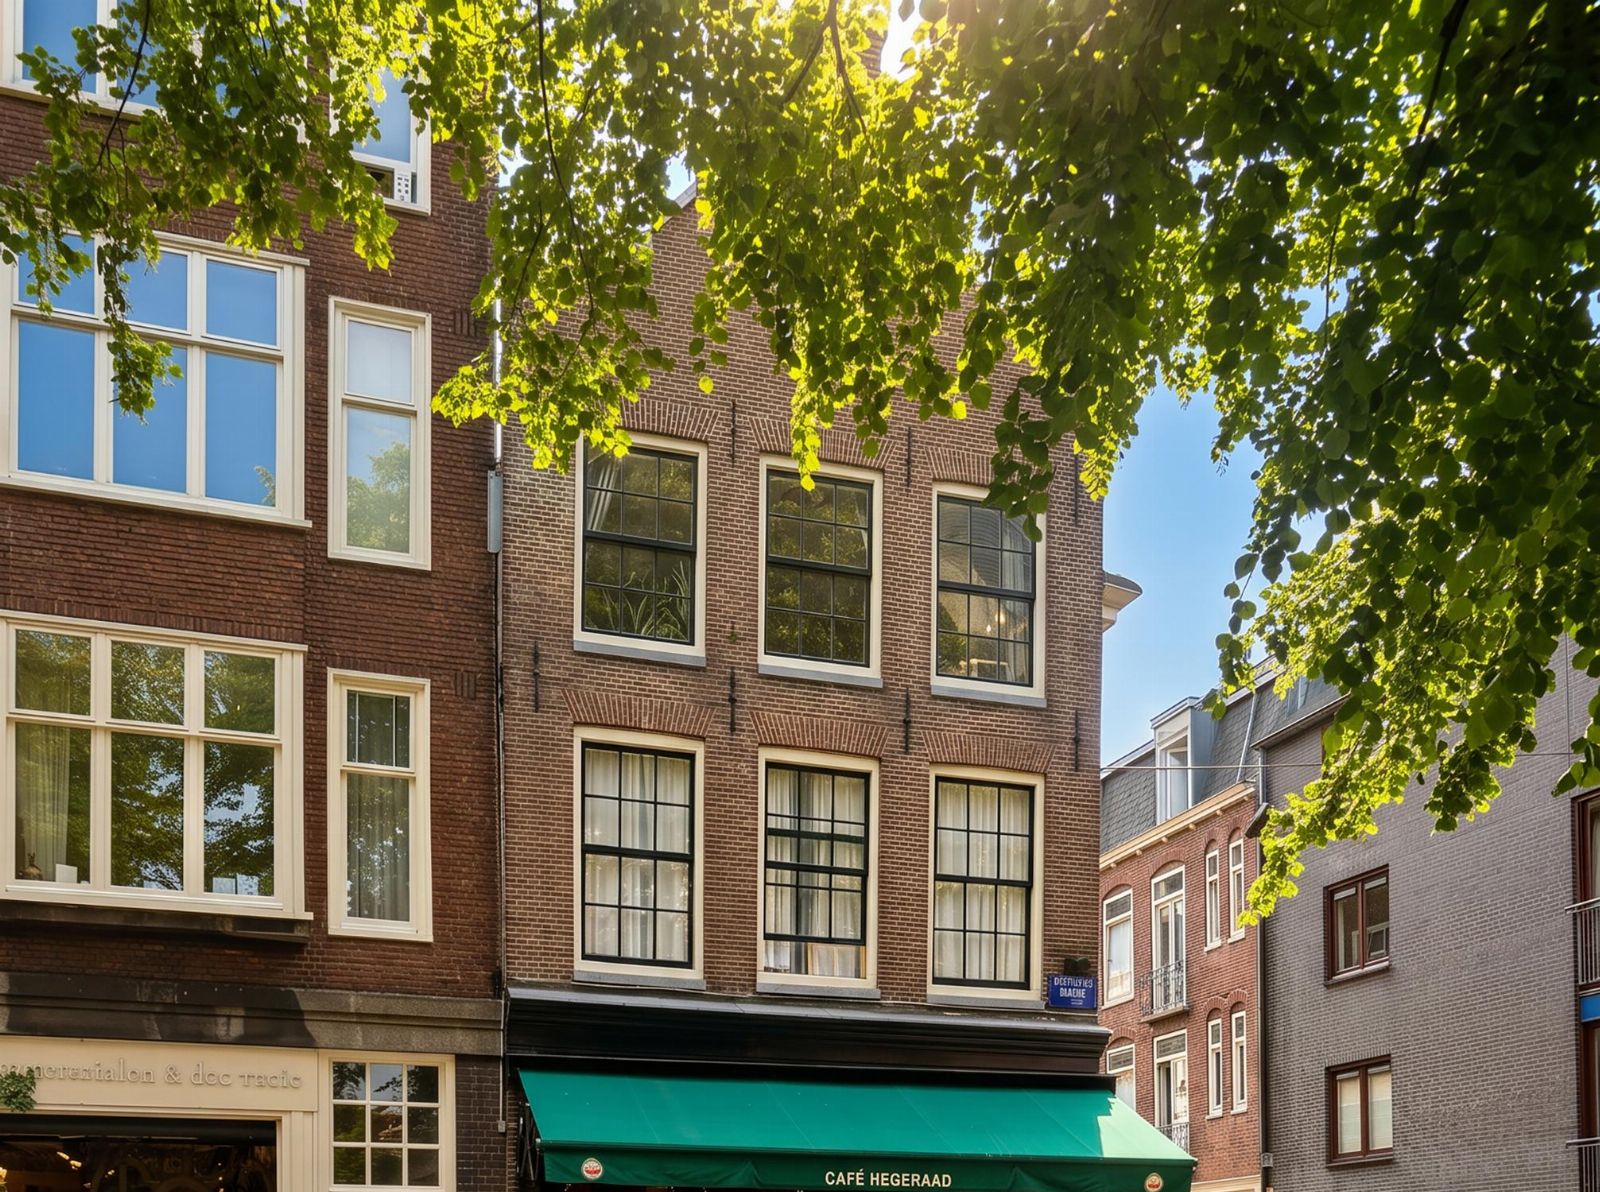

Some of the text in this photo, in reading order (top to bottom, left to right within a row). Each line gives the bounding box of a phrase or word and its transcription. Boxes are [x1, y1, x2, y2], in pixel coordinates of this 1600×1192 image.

[164, 1064, 182, 1085] &
[825, 1168, 952, 1188] CAFÉ HEGERAAD
